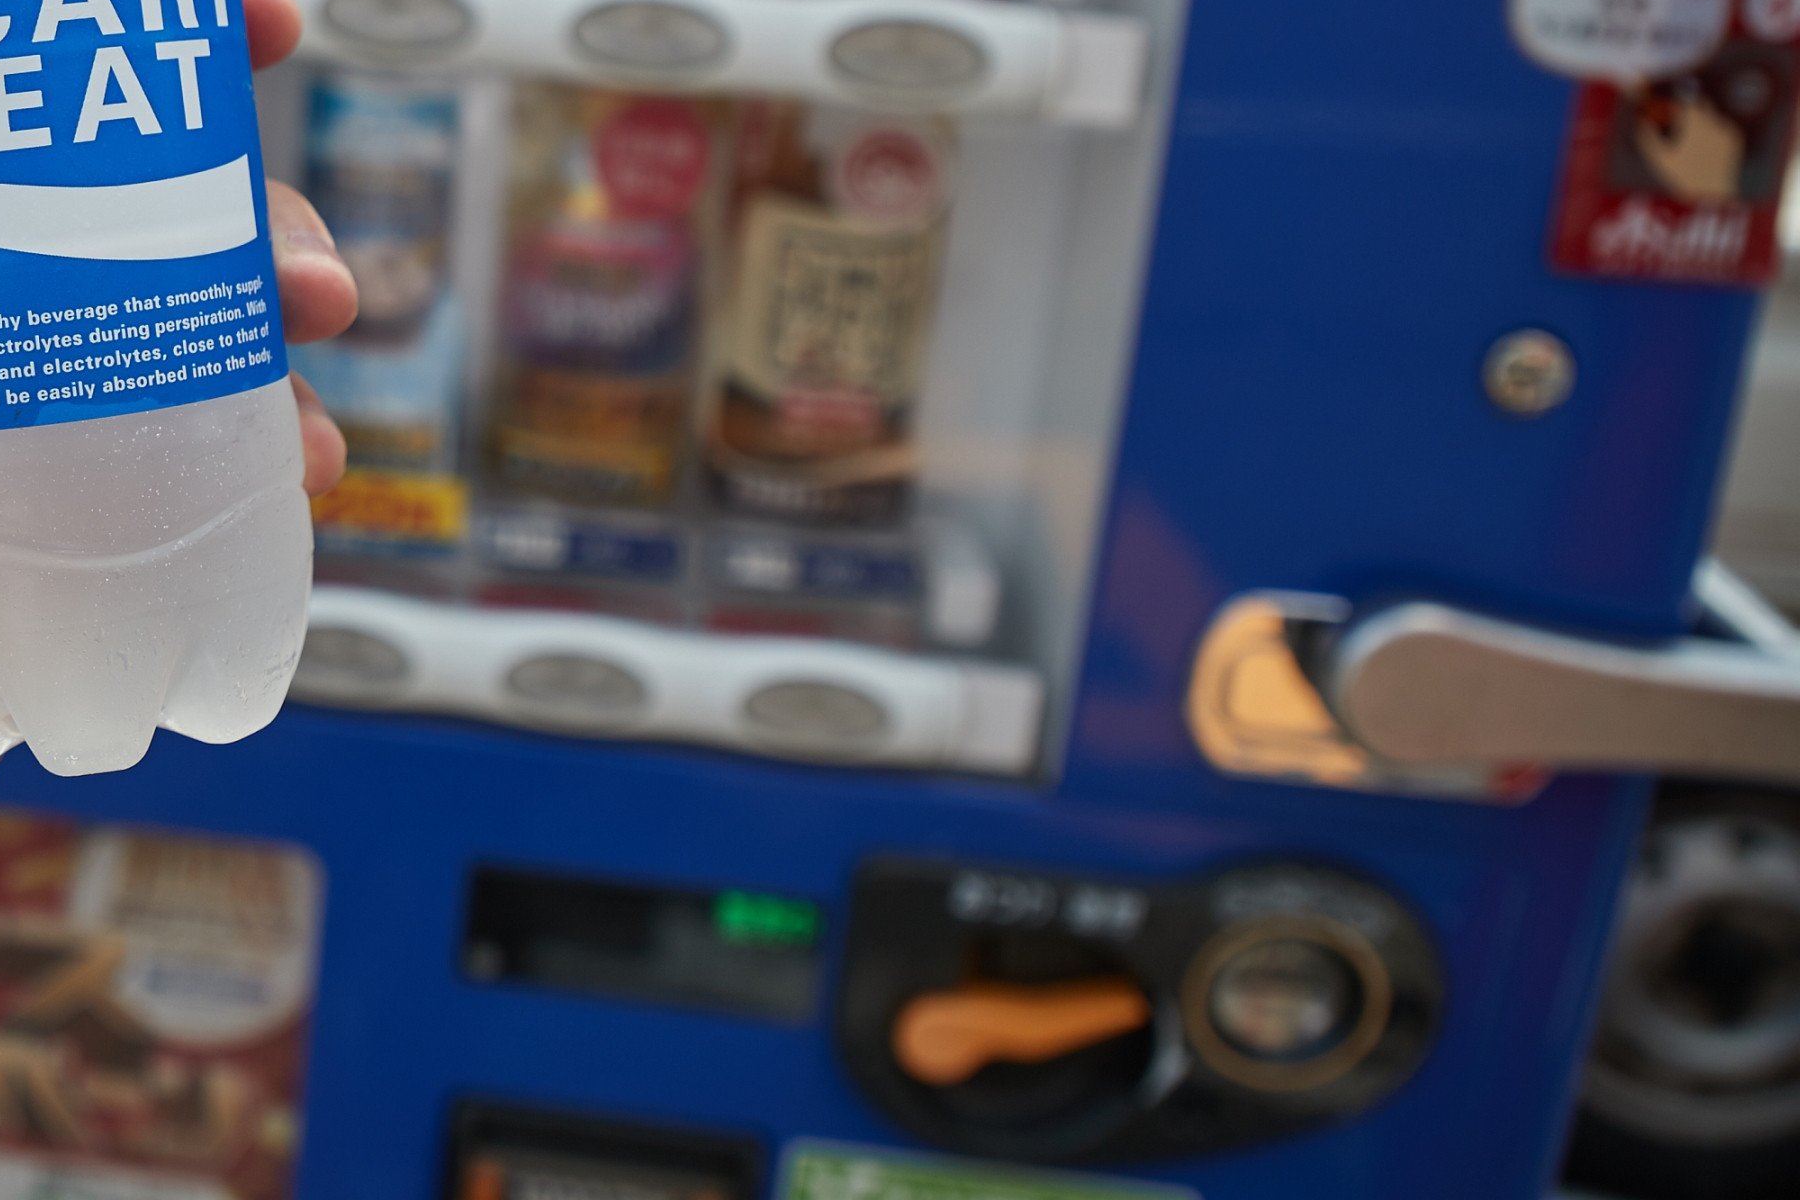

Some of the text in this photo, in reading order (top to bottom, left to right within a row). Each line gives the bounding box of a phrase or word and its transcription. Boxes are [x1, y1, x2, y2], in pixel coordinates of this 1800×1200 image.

[27, 303, 118, 326] beverage
[124, 295, 161, 313] that
[166, 281, 233, 307] smoothly
[89, 322, 150, 344] during
[155, 308, 245, 337] perspiration.
[246, 298, 267, 317] With
[42, 346, 167, 375] electrolytes,
[173, 335, 215, 357] close
[219, 333, 233, 348] to
[236, 326, 259, 345] that
[260, 322, 269, 338] of
[6, 389, 30, 405] be
[36, 381, 96, 401] easily
[102, 364, 188, 393] absorbed
[192, 360, 222, 379] into
[225, 354, 246, 372] the
[248, 347, 273, 366] body.
